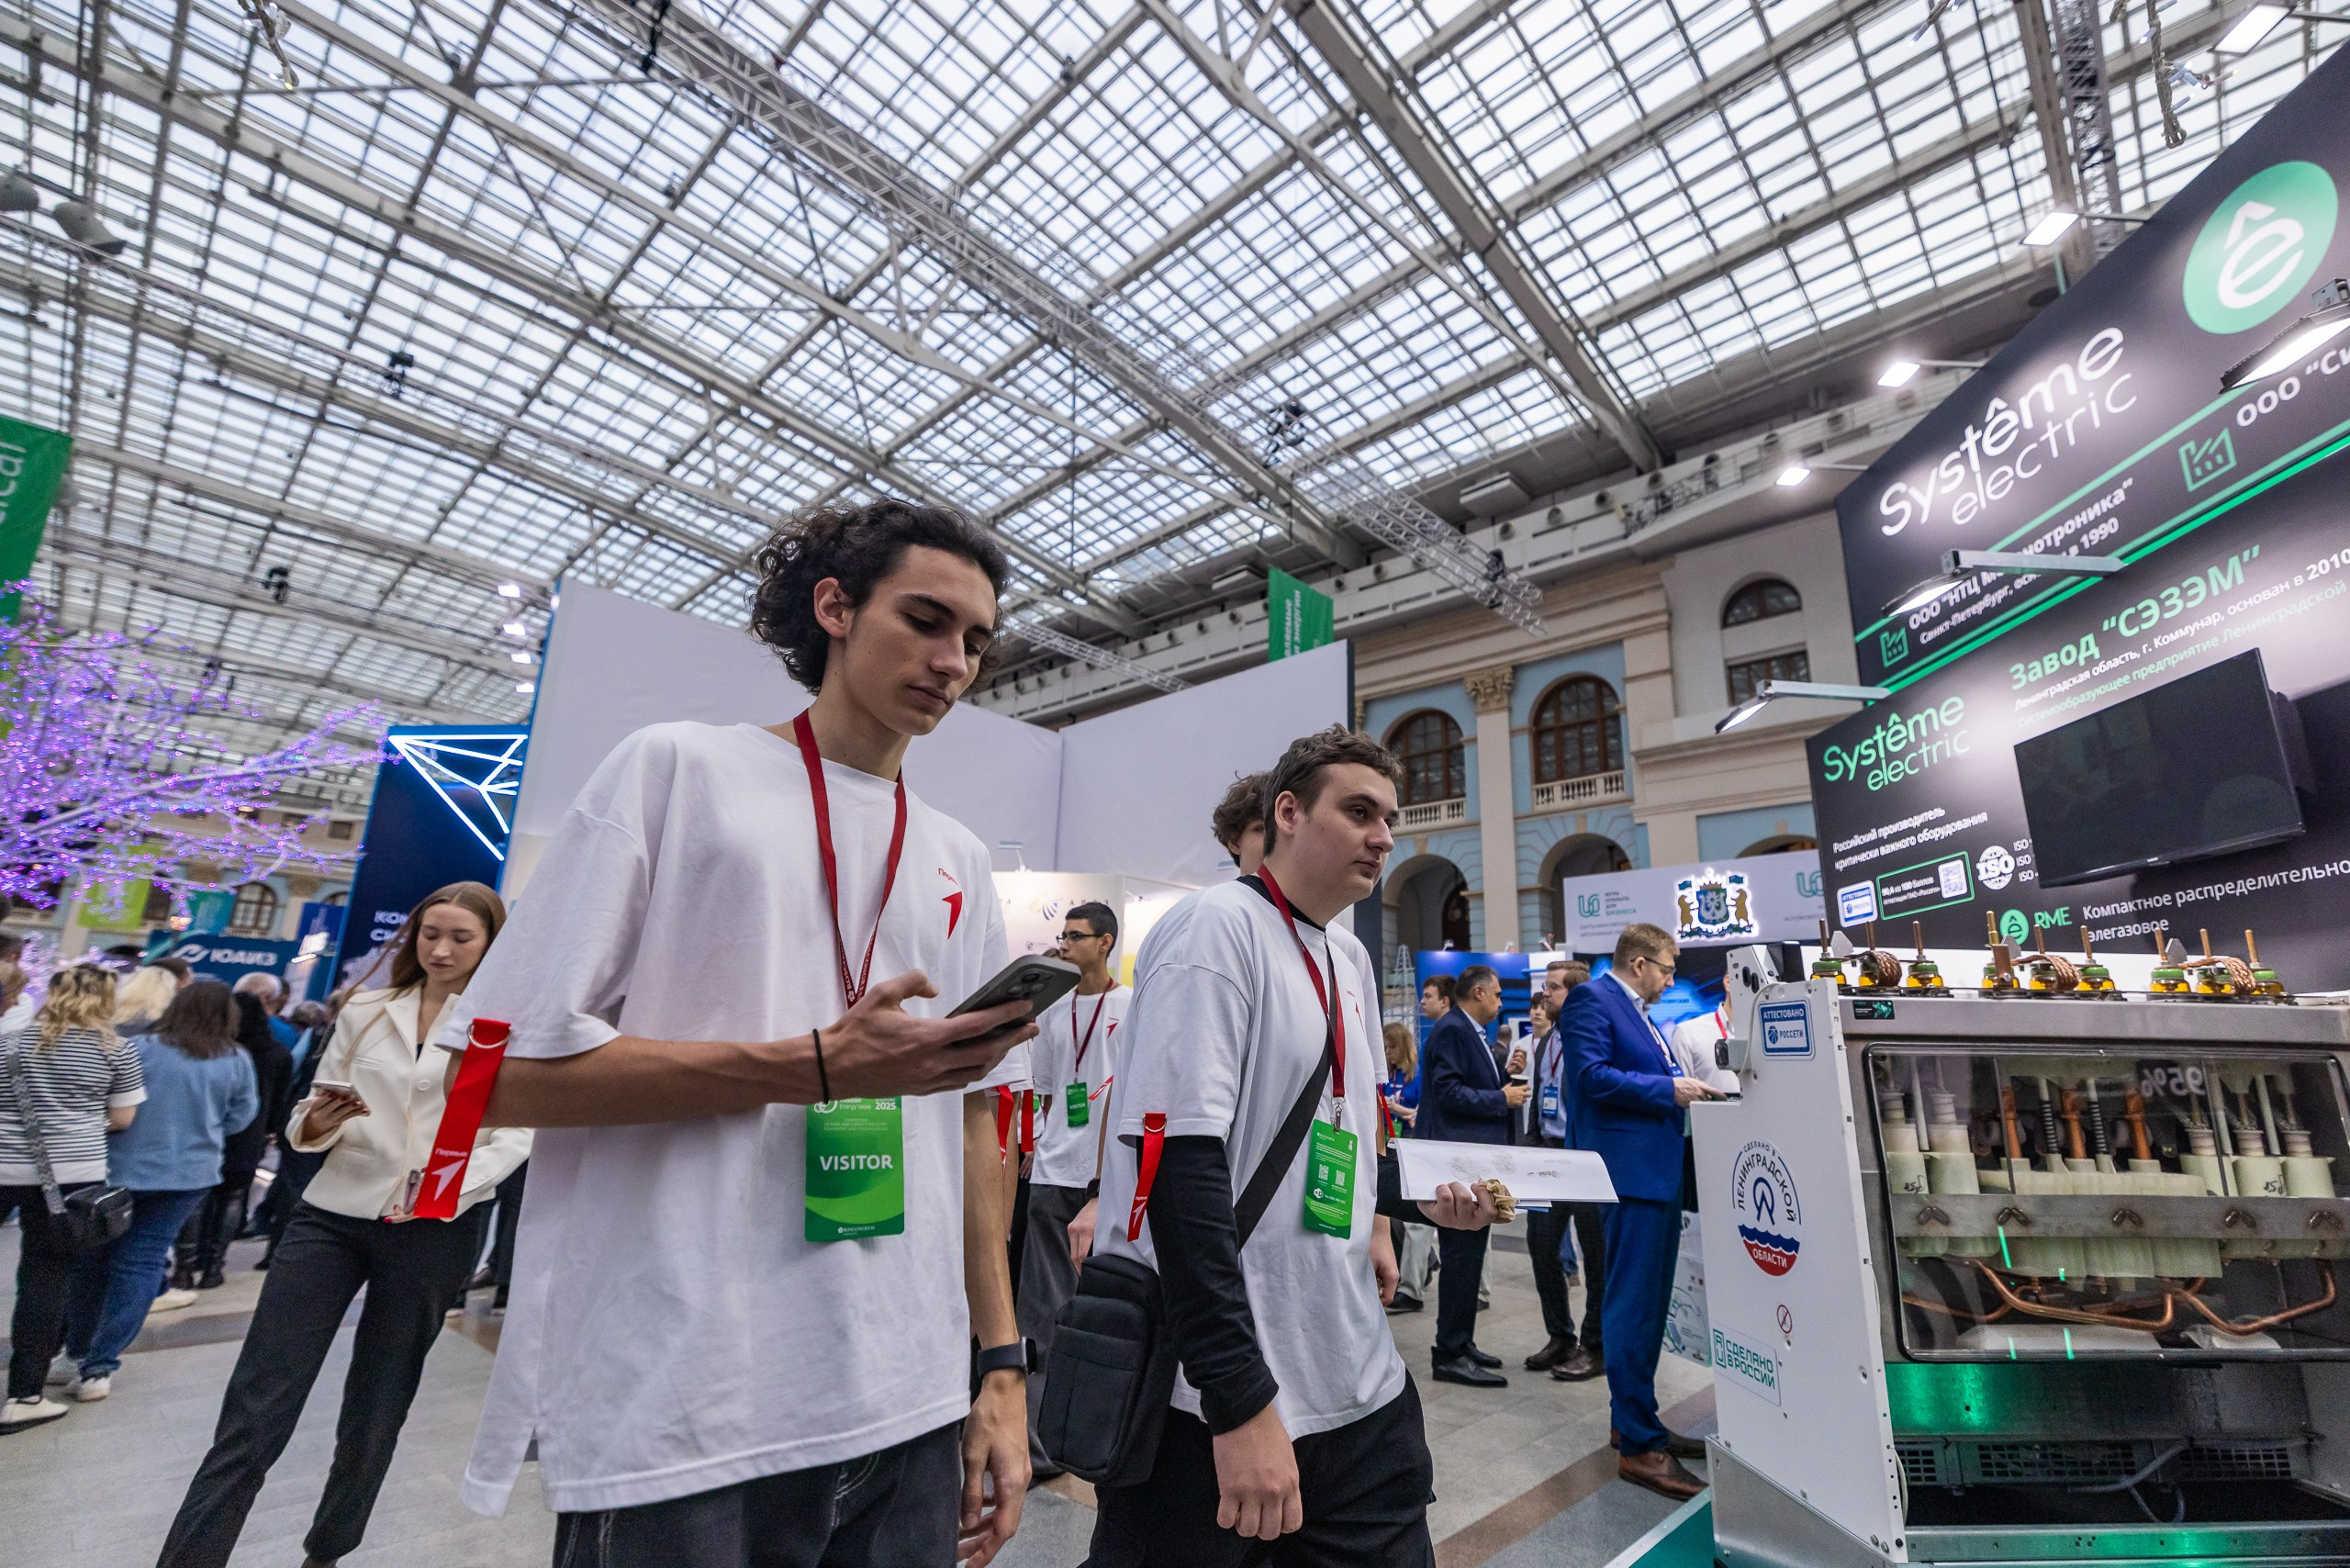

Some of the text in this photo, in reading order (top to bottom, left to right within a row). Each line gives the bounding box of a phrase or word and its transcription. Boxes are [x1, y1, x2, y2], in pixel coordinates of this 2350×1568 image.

[2236, 375, 2301, 427] ООО
[1880, 327, 2124, 536] Systême
[1952, 373, 2137, 525] electric
[2080, 517, 2120, 550] 1990
[1908, 599, 1942, 631] ООО
[2015, 547, 2350, 711] Ленинградская область, г. Коммунар, основан в 2010
[2009, 633, 2101, 691] Завод
[2017, 579, 2347, 728] Системообразующее предприятие Ленинградской
[1823, 696, 1965, 782] Systême
[1866, 730, 1971, 791] electric
[1832, 807, 1946, 854] Российский производитель
[1834, 812, 1989, 872] критически важного оборудования
[2013, 838, 2029, 852] ISO
[1975, 855, 2016, 881] ISO
[2016, 854, 2031, 867] ISO
[2019, 869, 2035, 882] ISO
[2082, 859, 2350, 921] Компактное распределительно
[2033, 906, 2073, 929] RME
[2087, 919, 2169, 943] элегазовое
[1762, 1008, 1805, 1020] АТТЕСТОВАНО
[1779, 1029, 1804, 1039] РОССЕТИ
[875, 1102, 897, 1111] 2025
[819, 1155, 894, 1171] VISITOR
[1743, 1140, 1770, 1153] СДЕЛАНО
[1738, 1153, 1797, 1223] ЛЕНИНГРАДСКОЙ
[1752, 1248, 1788, 1269] ОБЛАСТИ
[1726, 1338, 1774, 1374] СДЕЛАНО
